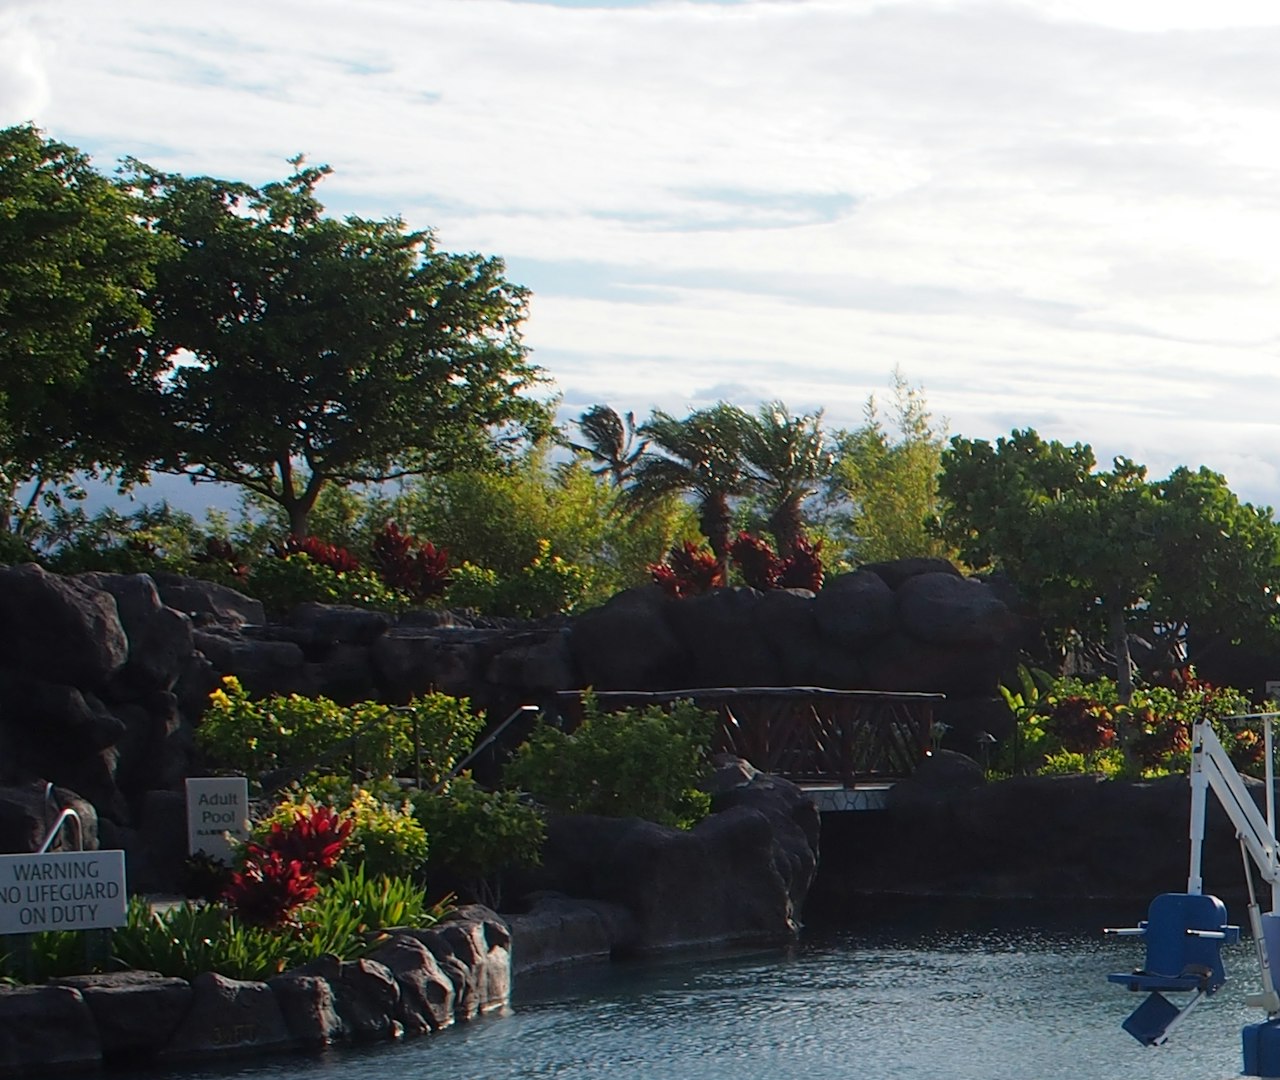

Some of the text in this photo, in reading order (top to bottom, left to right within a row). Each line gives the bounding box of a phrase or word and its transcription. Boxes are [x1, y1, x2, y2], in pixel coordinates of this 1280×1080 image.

[198, 793, 239, 806] Adult
[202, 811, 235, 823] Pool
[13, 861, 99, 881] WARNING
[27, 881, 119, 902] LIFEGUARD
[20, 904, 98, 925] ON DUTY
